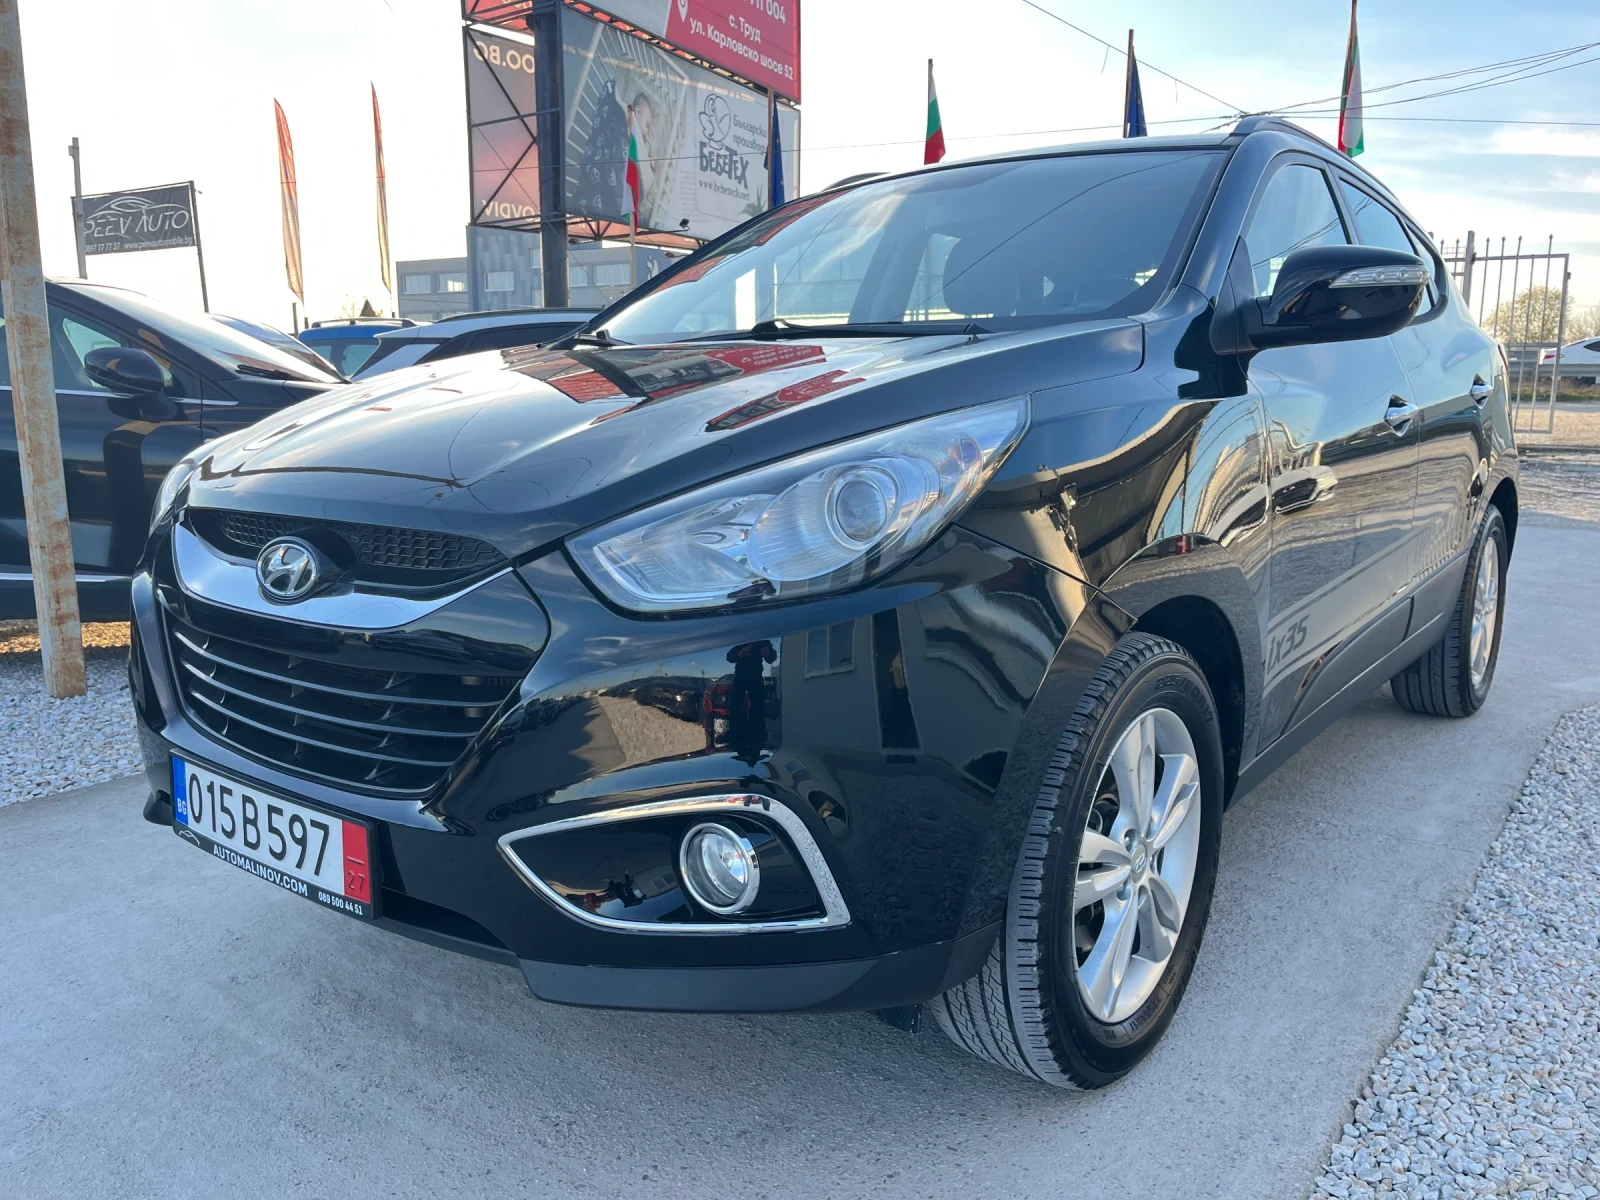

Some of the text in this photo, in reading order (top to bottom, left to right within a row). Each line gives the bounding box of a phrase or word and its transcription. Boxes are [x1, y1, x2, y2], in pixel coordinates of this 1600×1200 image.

[766, 0, 786, 24] 004
[728, 15, 761, 44] с. Труд
[690, 17, 793, 80] ул. Карловско шосе 52
[699, 180, 750, 201] www.bebetech.net
[84, 210, 189, 237] PEEV AUTO
[1267, 613, 1310, 675] ix35
[177, 797, 187, 816] BG
[189, 773, 330, 876] 015B597
[213, 844, 364, 916] AUTOMALINOV.COM 089 500 44 51
[347, 870, 366, 893] 27
